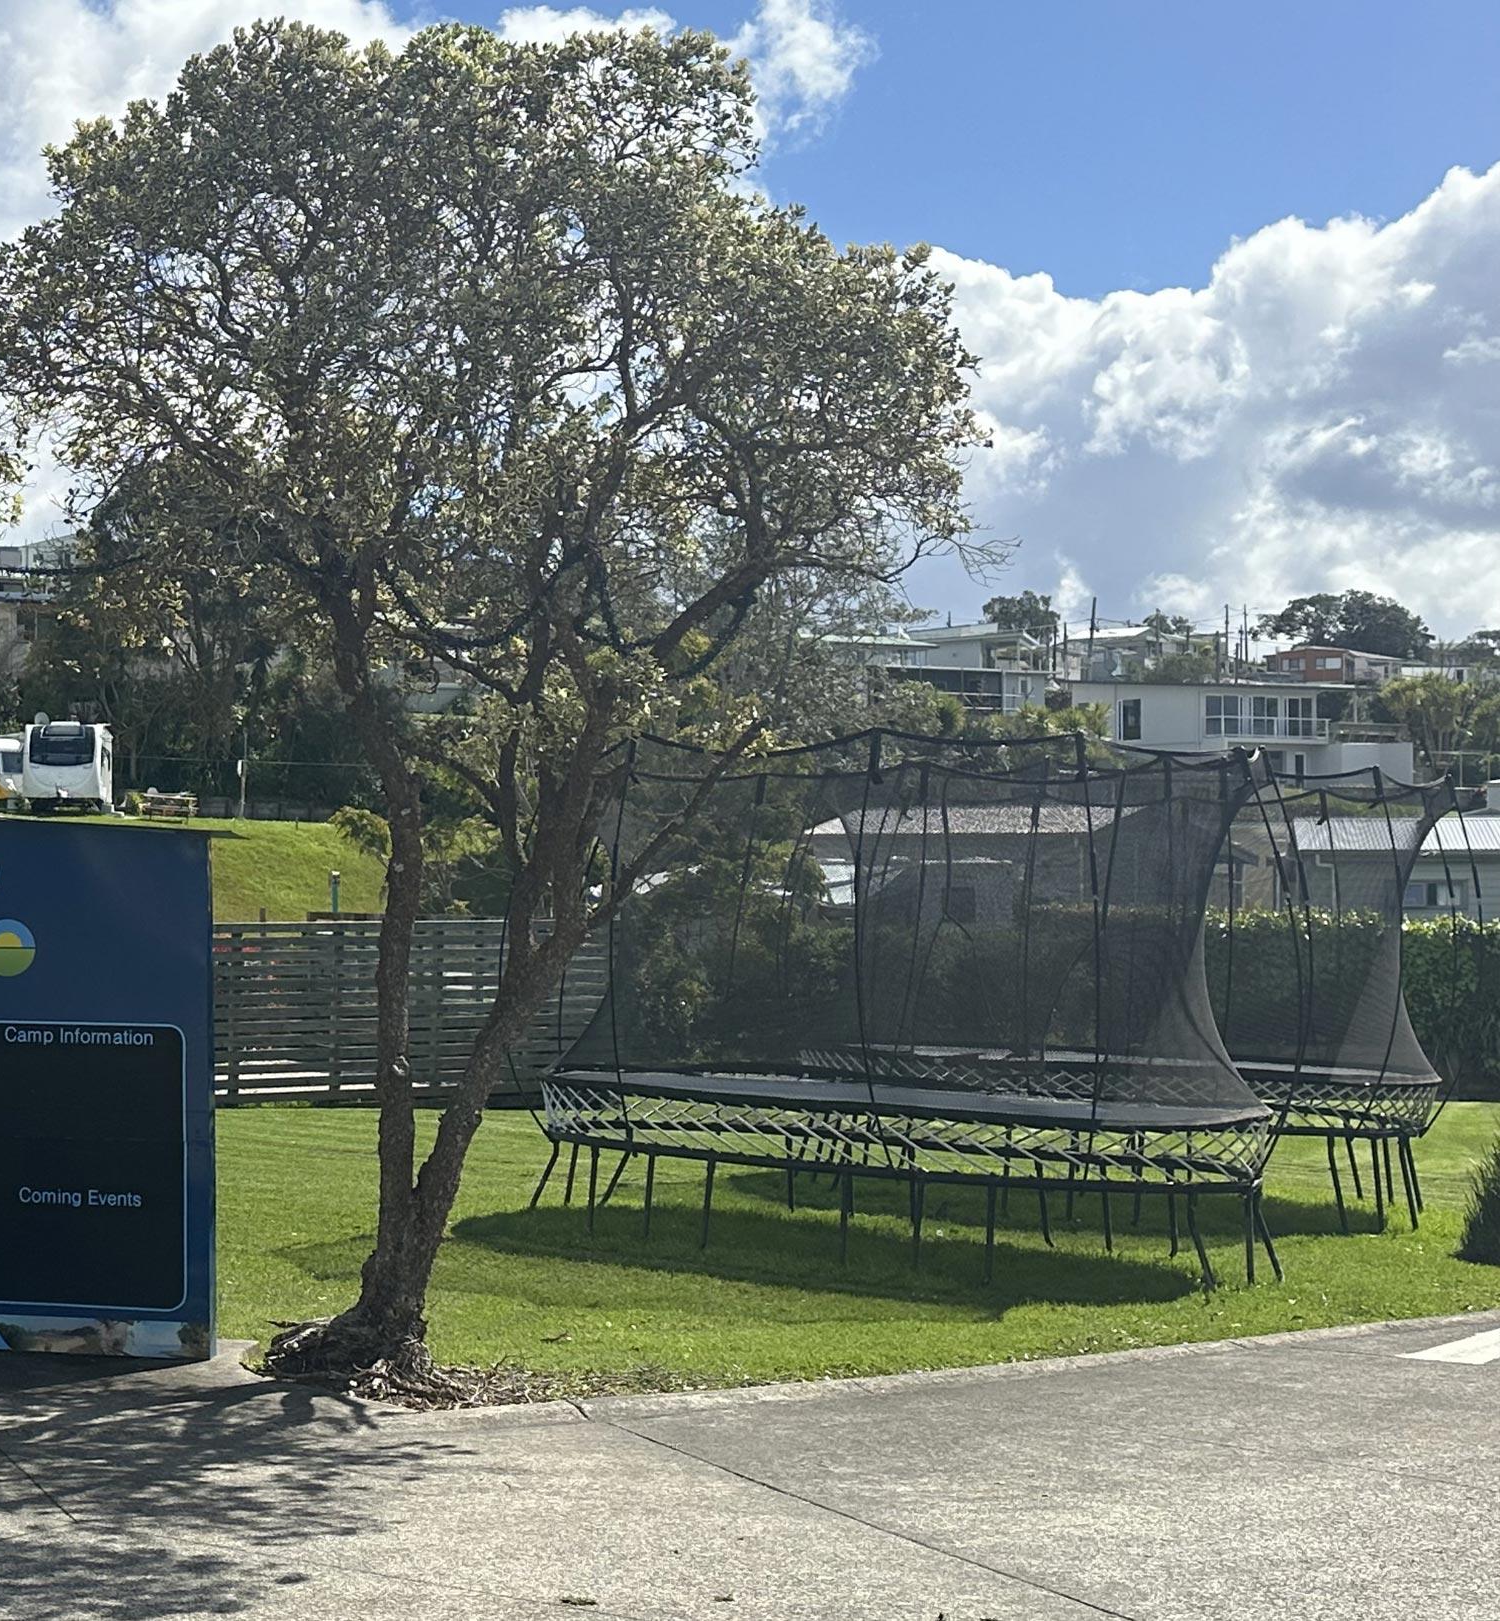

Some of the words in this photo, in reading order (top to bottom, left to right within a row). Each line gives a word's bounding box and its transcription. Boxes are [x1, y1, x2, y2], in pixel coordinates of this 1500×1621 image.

[5, 1026, 53, 1045] Camp
[60, 1028, 154, 1045] Information
[19, 1187, 81, 1207] Coming
[88, 1189, 142, 1207] Events
